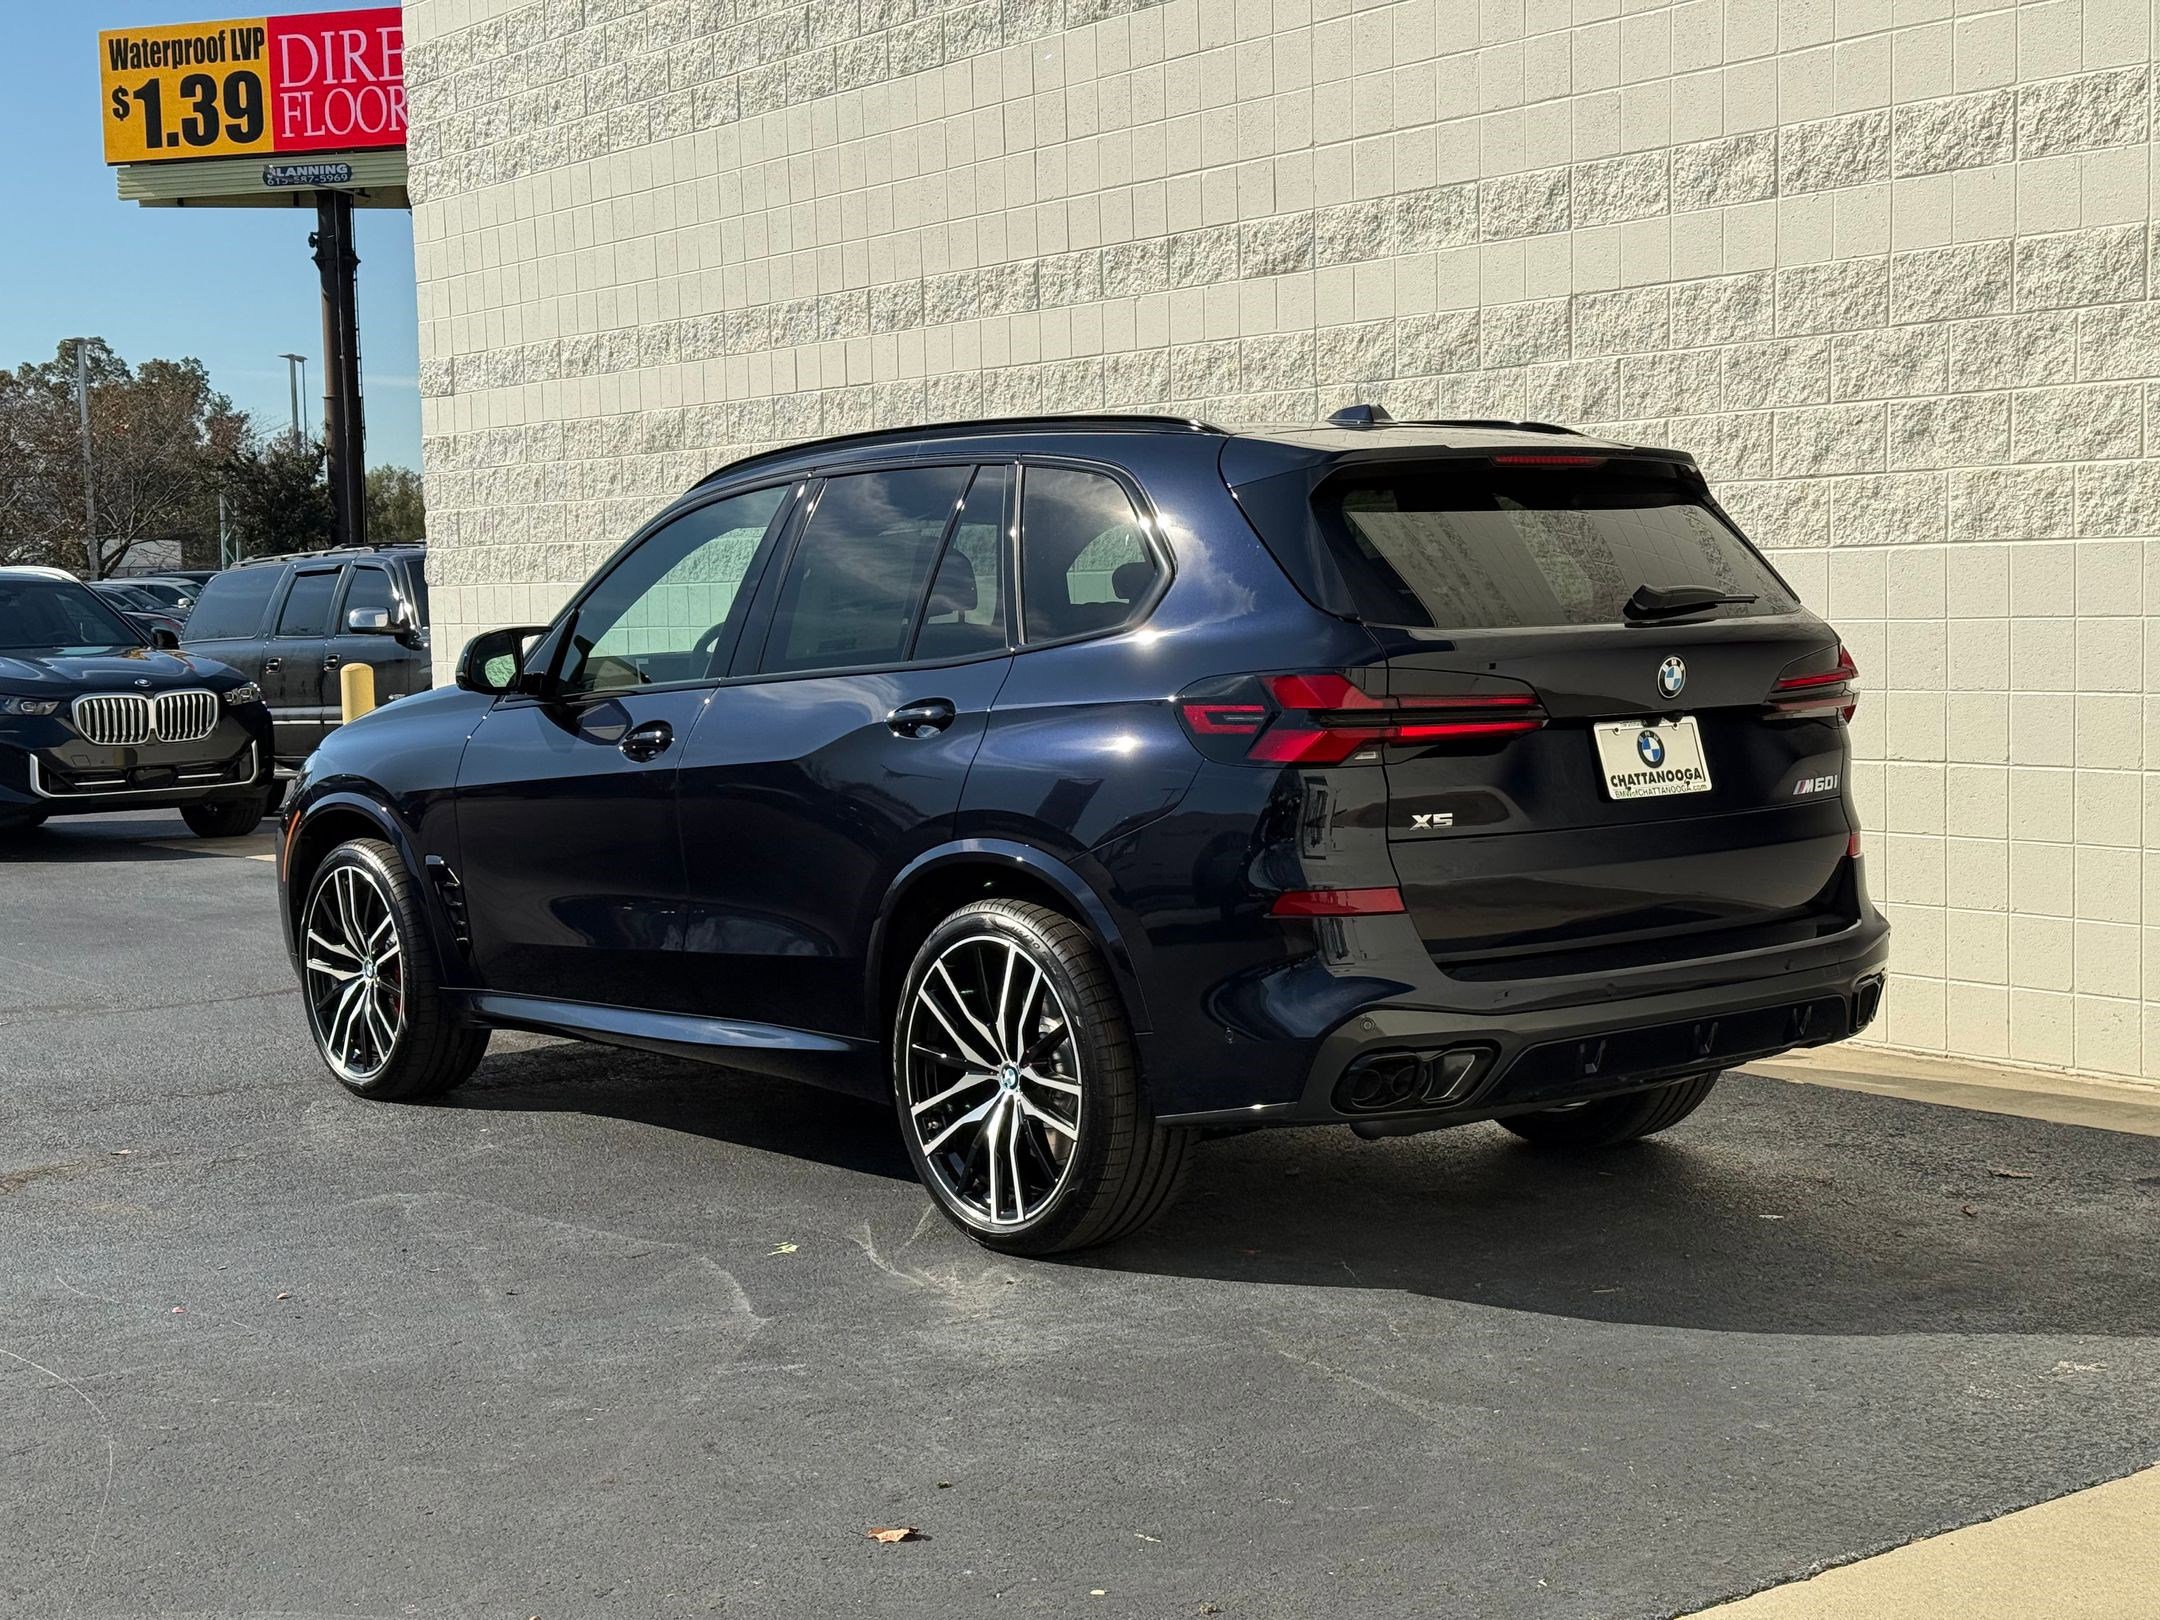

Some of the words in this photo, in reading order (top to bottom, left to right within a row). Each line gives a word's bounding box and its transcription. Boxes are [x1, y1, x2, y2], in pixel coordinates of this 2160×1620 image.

[108, 30, 226, 71] Waterproof
[231, 27, 265, 61] LVP
[111, 70, 265, 149] $1.39
[1609, 768, 1702, 788] CHATTANOOGA
[1408, 812, 1453, 831] X5
